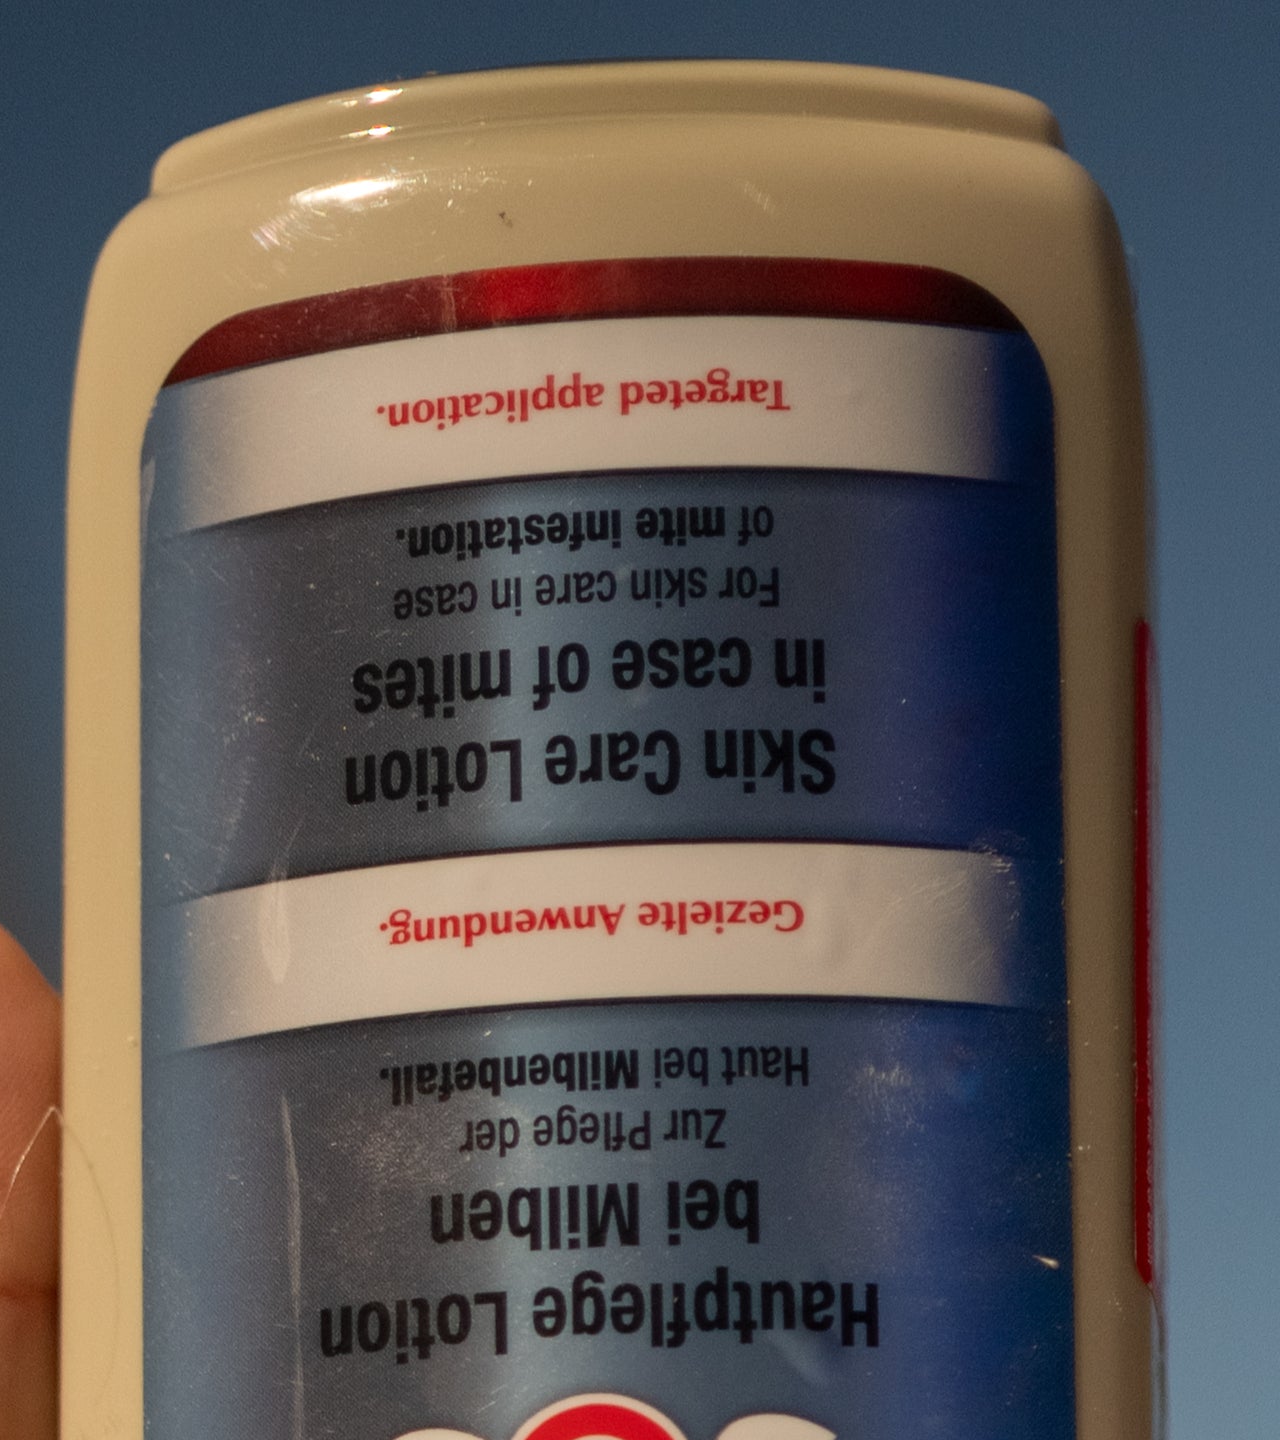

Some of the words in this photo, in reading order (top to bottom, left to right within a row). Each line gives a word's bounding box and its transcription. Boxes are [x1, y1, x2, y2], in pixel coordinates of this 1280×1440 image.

[376, 372, 605, 431] application.
[620, 368, 791, 415] Targeted
[395, 510, 621, 559] infestation.
[635, 507, 725, 547] mite
[738, 505, 774, 546] of
[393, 581, 478, 621] case
[491, 577, 521, 617] in
[535, 570, 617, 607] care
[630, 568, 708, 609] skin
[720, 566, 780, 607] For
[351, 648, 511, 719] mites
[532, 642, 590, 710] of
[612, 637, 753, 693] case
[774, 638, 826, 704] in
[344, 738, 522, 812] Lotion
[545, 729, 680, 796] Care
[704, 728, 836, 794] Skin
[378, 904, 626, 948] Anwendung.
[638, 899, 805, 935] Gezielte
[379, 1049, 639, 1105] Milbenbefall.
[654, 1046, 709, 1088] bei
[722, 1046, 810, 1087] Haut
[459, 1118, 519, 1157] der
[533, 1105, 651, 1151] Pflege
[664, 1108, 727, 1149] Zur
[430, 1183, 640, 1251] Milben
[667, 1180, 760, 1245] bei
[320, 1291, 509, 1365] Lotion
[532, 1266, 880, 1348] Hautpflege
